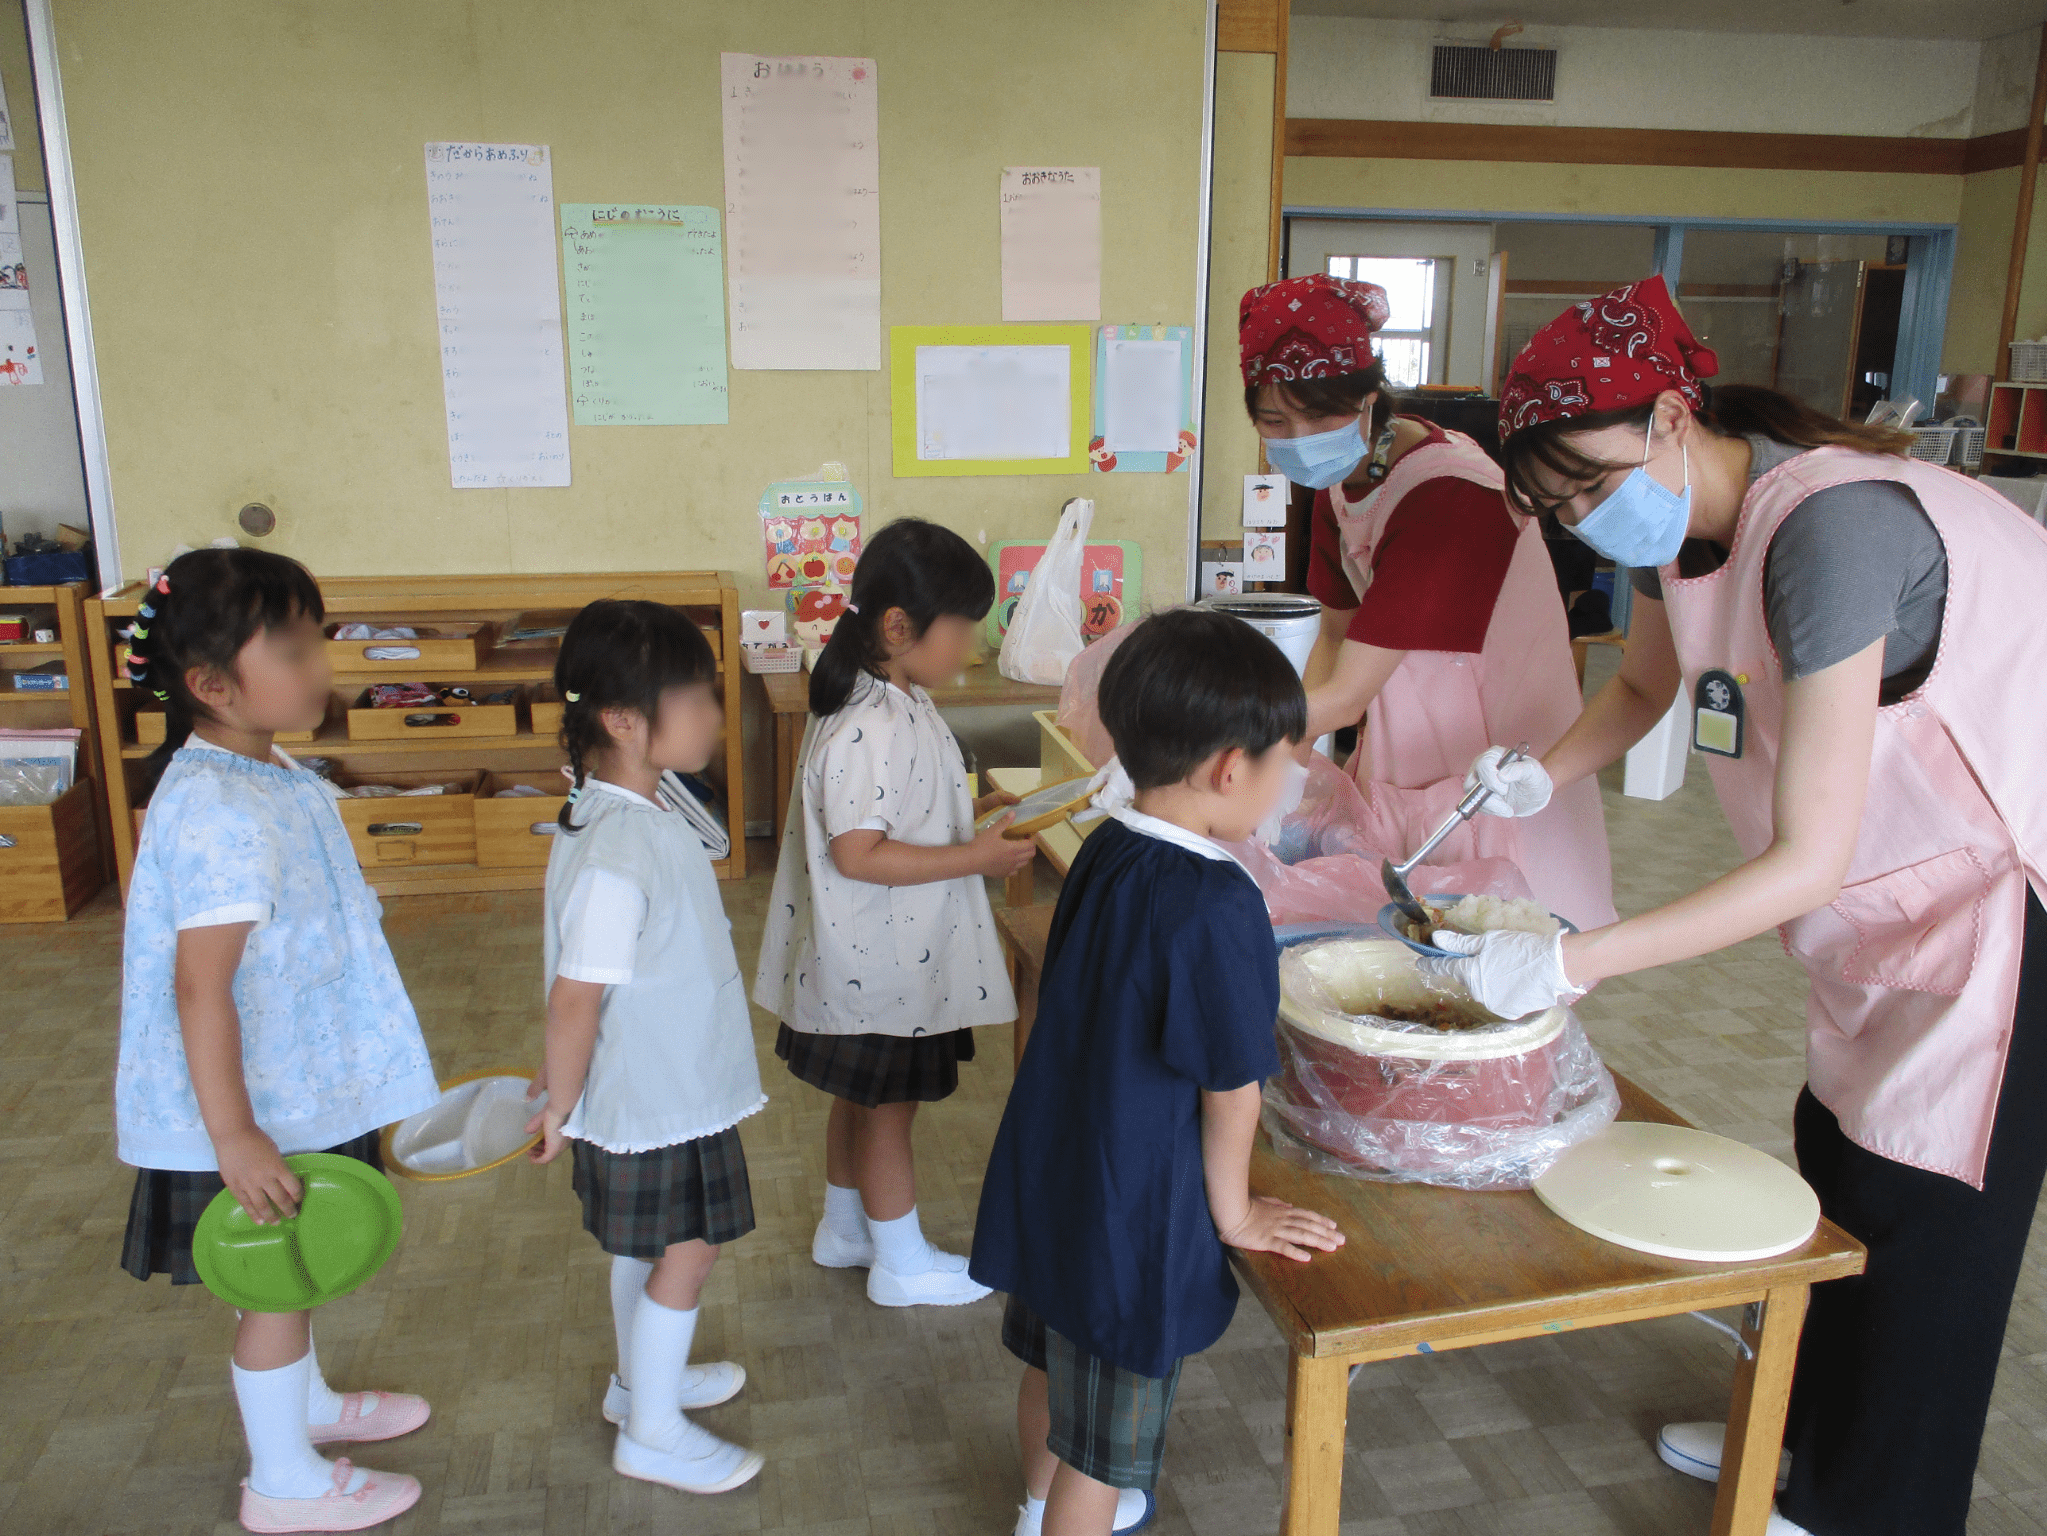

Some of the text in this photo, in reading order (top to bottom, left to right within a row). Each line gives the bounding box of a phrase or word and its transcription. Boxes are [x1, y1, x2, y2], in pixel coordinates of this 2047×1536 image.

[446, 145, 528, 162] だからあめふり
[1021, 170, 1075, 185] おおきなうた
[780, 492, 847, 505] おとうばん
[1090, 603, 1115, 626] か
